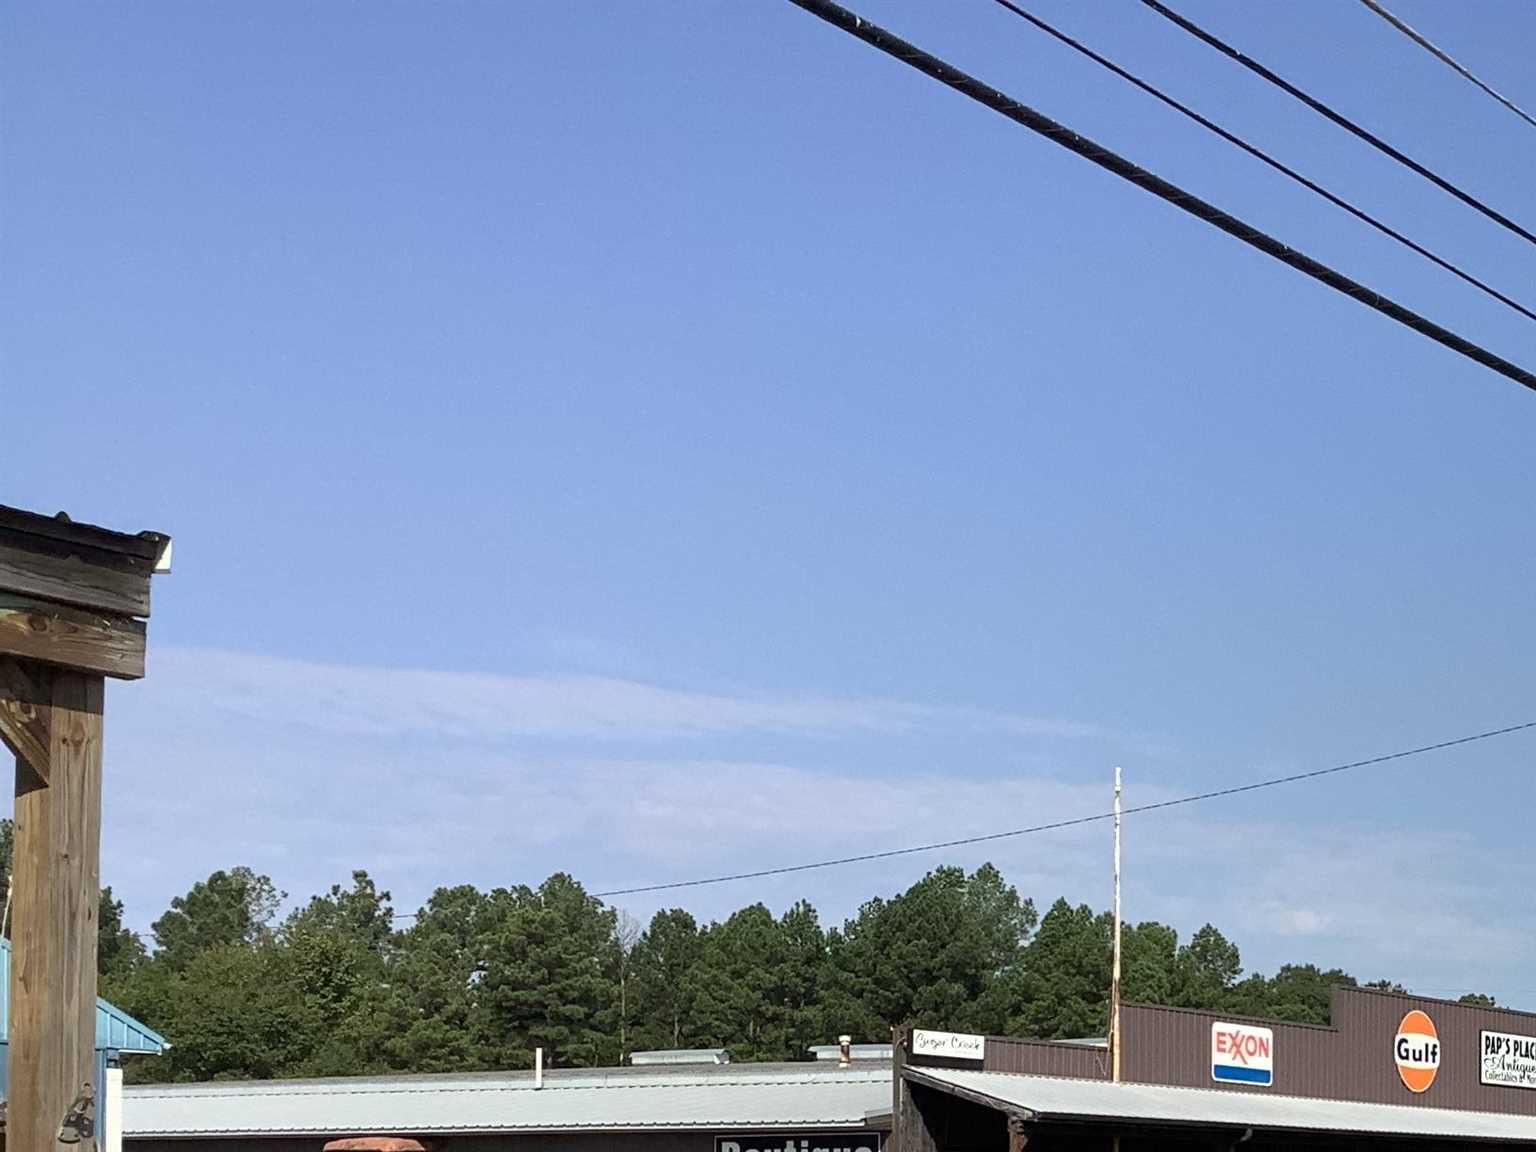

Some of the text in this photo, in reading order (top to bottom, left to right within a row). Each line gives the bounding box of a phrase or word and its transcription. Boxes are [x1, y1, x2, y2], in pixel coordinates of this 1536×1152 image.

[1216, 1030, 1270, 1065] EXXON
[1397, 1037, 1438, 1063] Gulf
[1485, 1035, 1511, 1056] PAP'S
